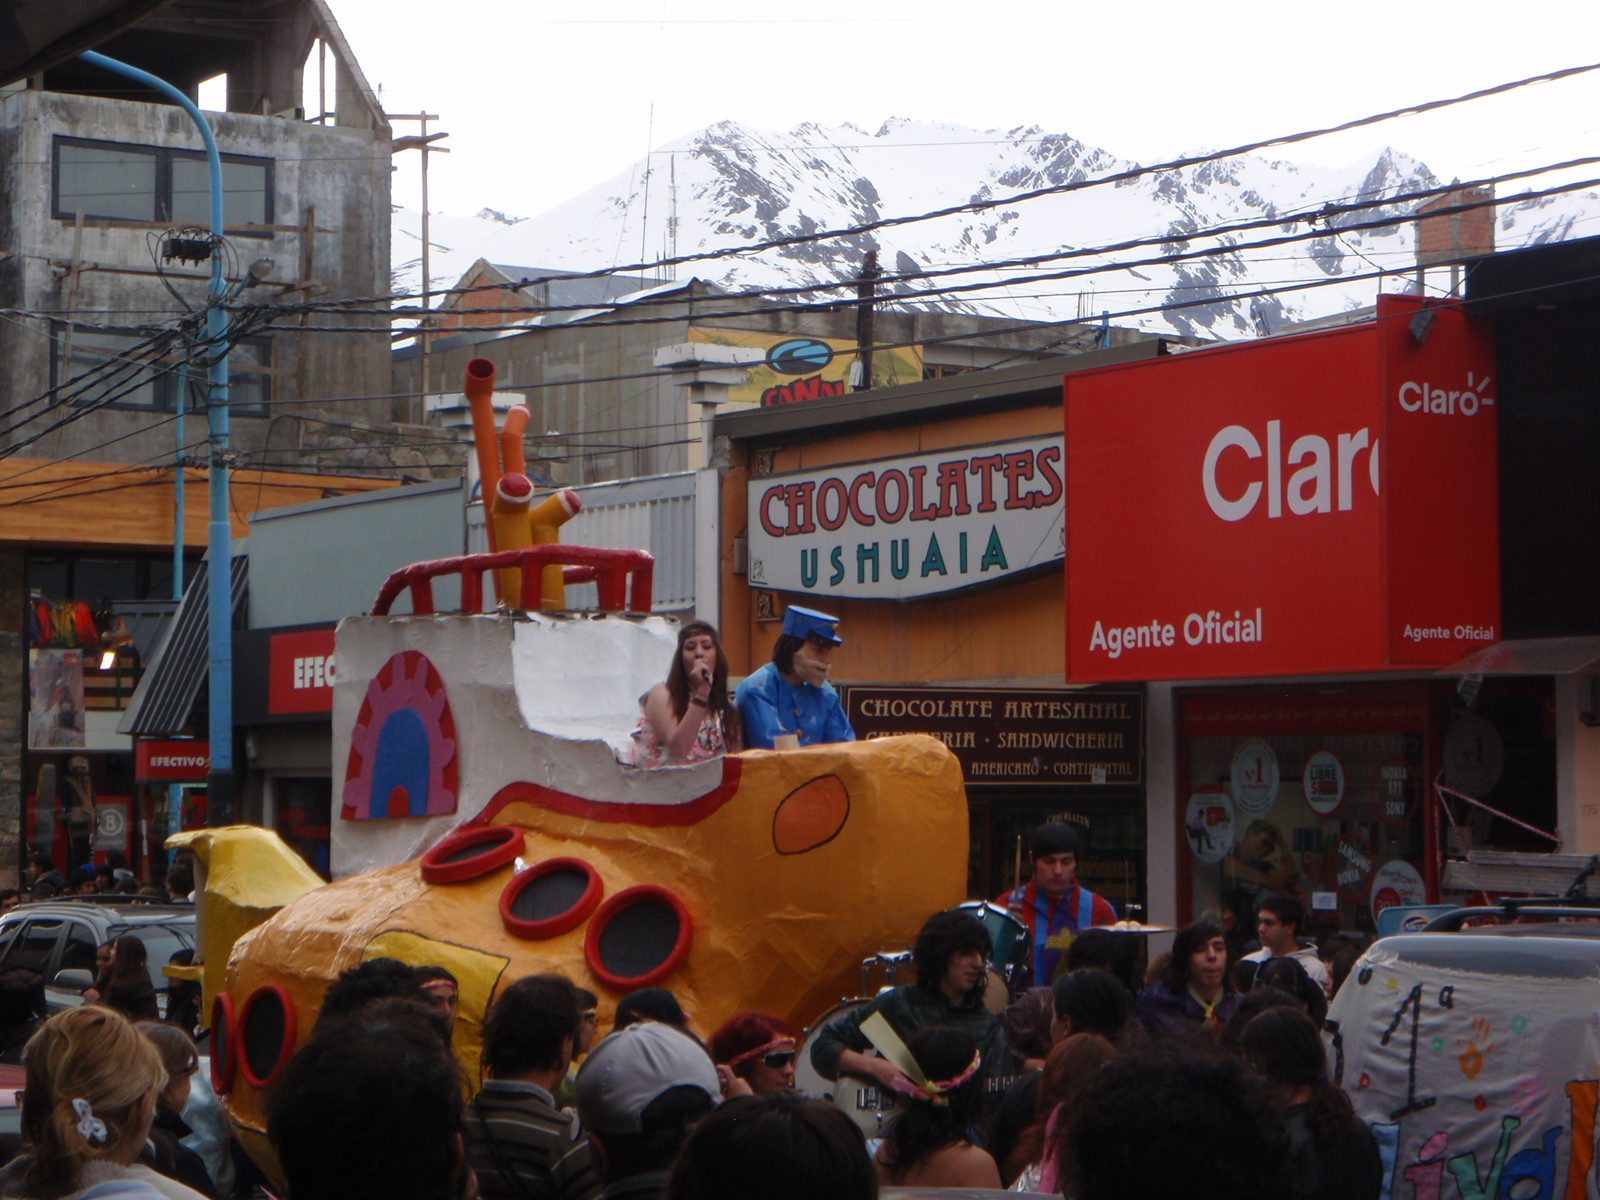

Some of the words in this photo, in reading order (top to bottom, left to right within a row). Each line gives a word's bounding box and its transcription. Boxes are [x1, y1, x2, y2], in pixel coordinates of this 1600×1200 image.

[1398, 373, 1494, 416] Claro
[1202, 420, 1380, 522] Clar
[759, 446, 1063, 538] CHOCOLATES
[800, 524, 1009, 588] USHUAIA
[1089, 618, 1176, 659] Agente
[1183, 607, 1263, 647] Oficial
[1403, 624, 1451, 642] Agente
[1454, 624, 1495, 642] Oficial
[860, 699, 993, 718] CHOCOLATE
[1004, 700, 1131, 720] ARTESANAL
[997, 731, 1125, 749] SANDWICHERIA
[150, 756, 205, 767] EFECTIVO
[1310, 769, 1337, 780] LIBRE
[1385, 801, 1407, 815] SONY
[1337, 840, 1373, 874] SAMSUNG
[1336, 869, 1361, 887] NOKIA
